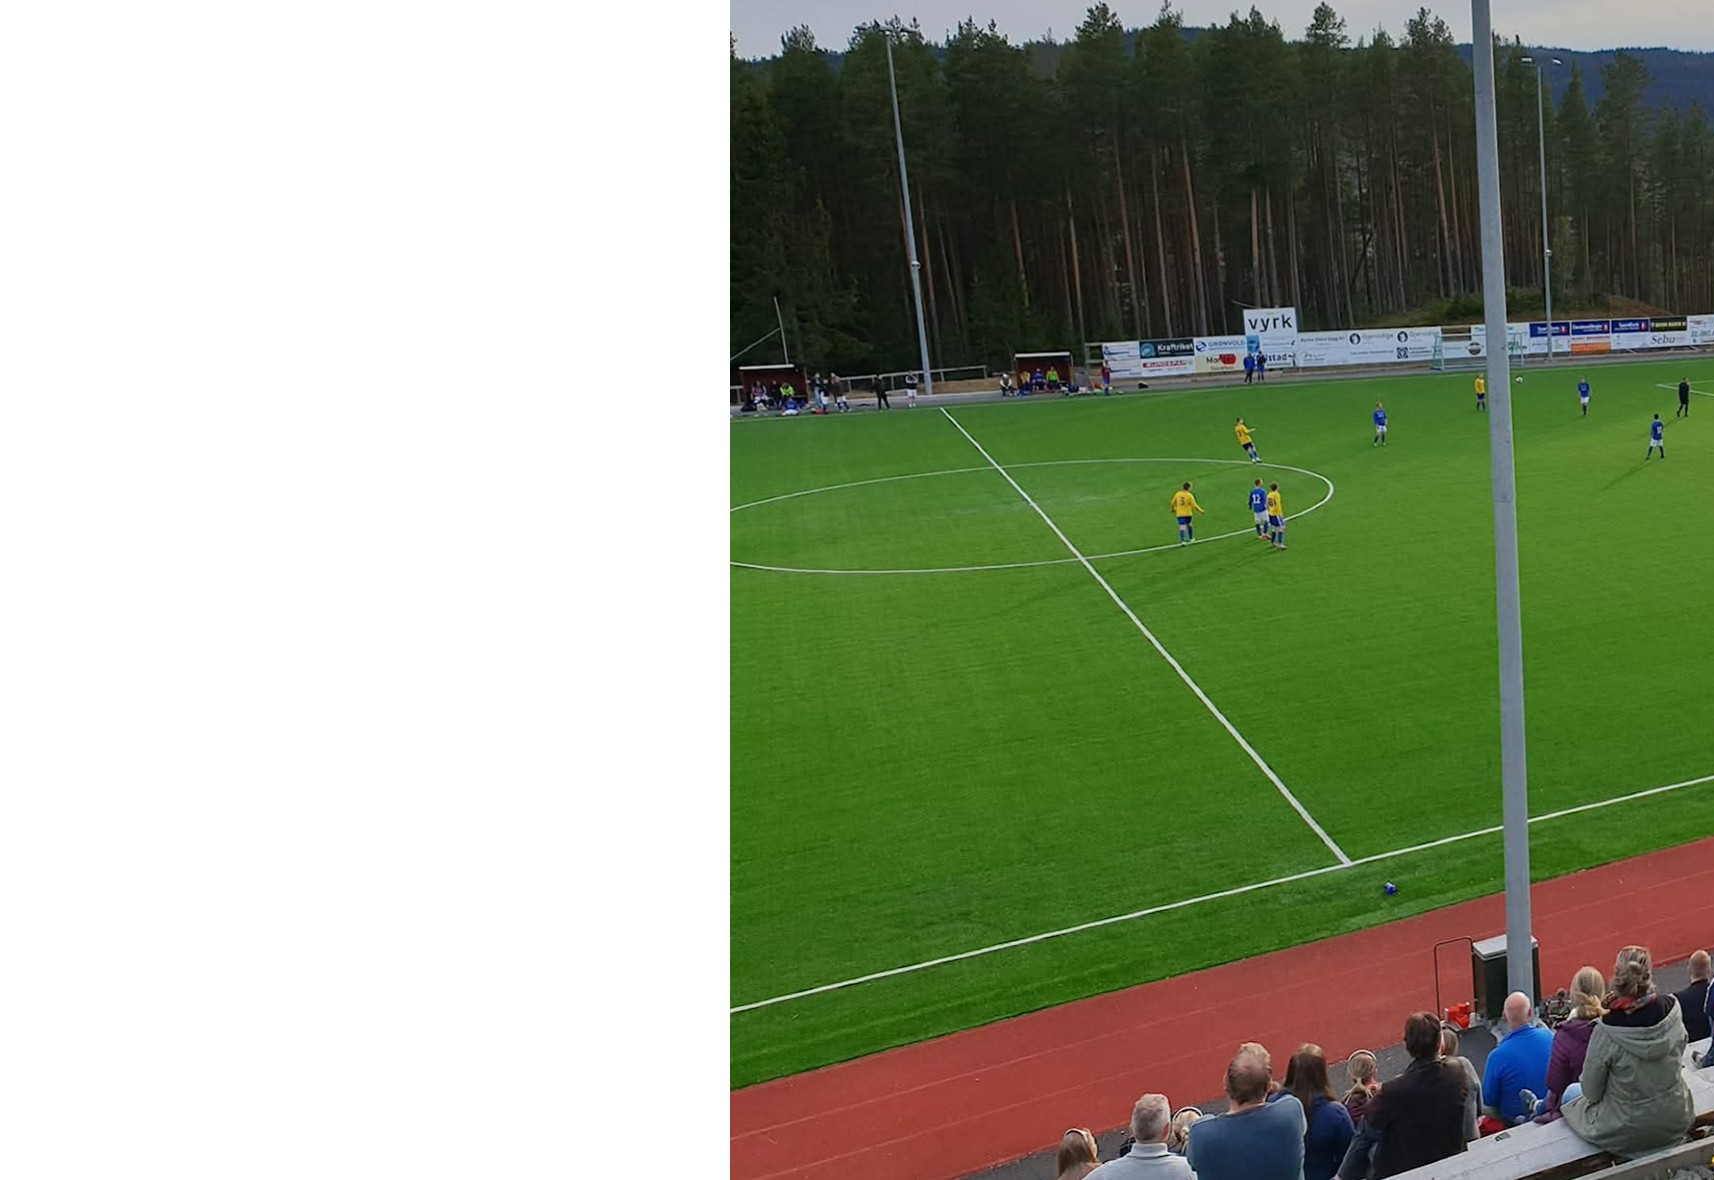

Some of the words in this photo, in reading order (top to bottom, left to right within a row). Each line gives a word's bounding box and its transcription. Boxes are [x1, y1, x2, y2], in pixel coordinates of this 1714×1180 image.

[1248, 314, 1293, 332] vyrk
[1157, 343, 1194, 351] Kraftriket
[1252, 494, 1261, 504] 12
